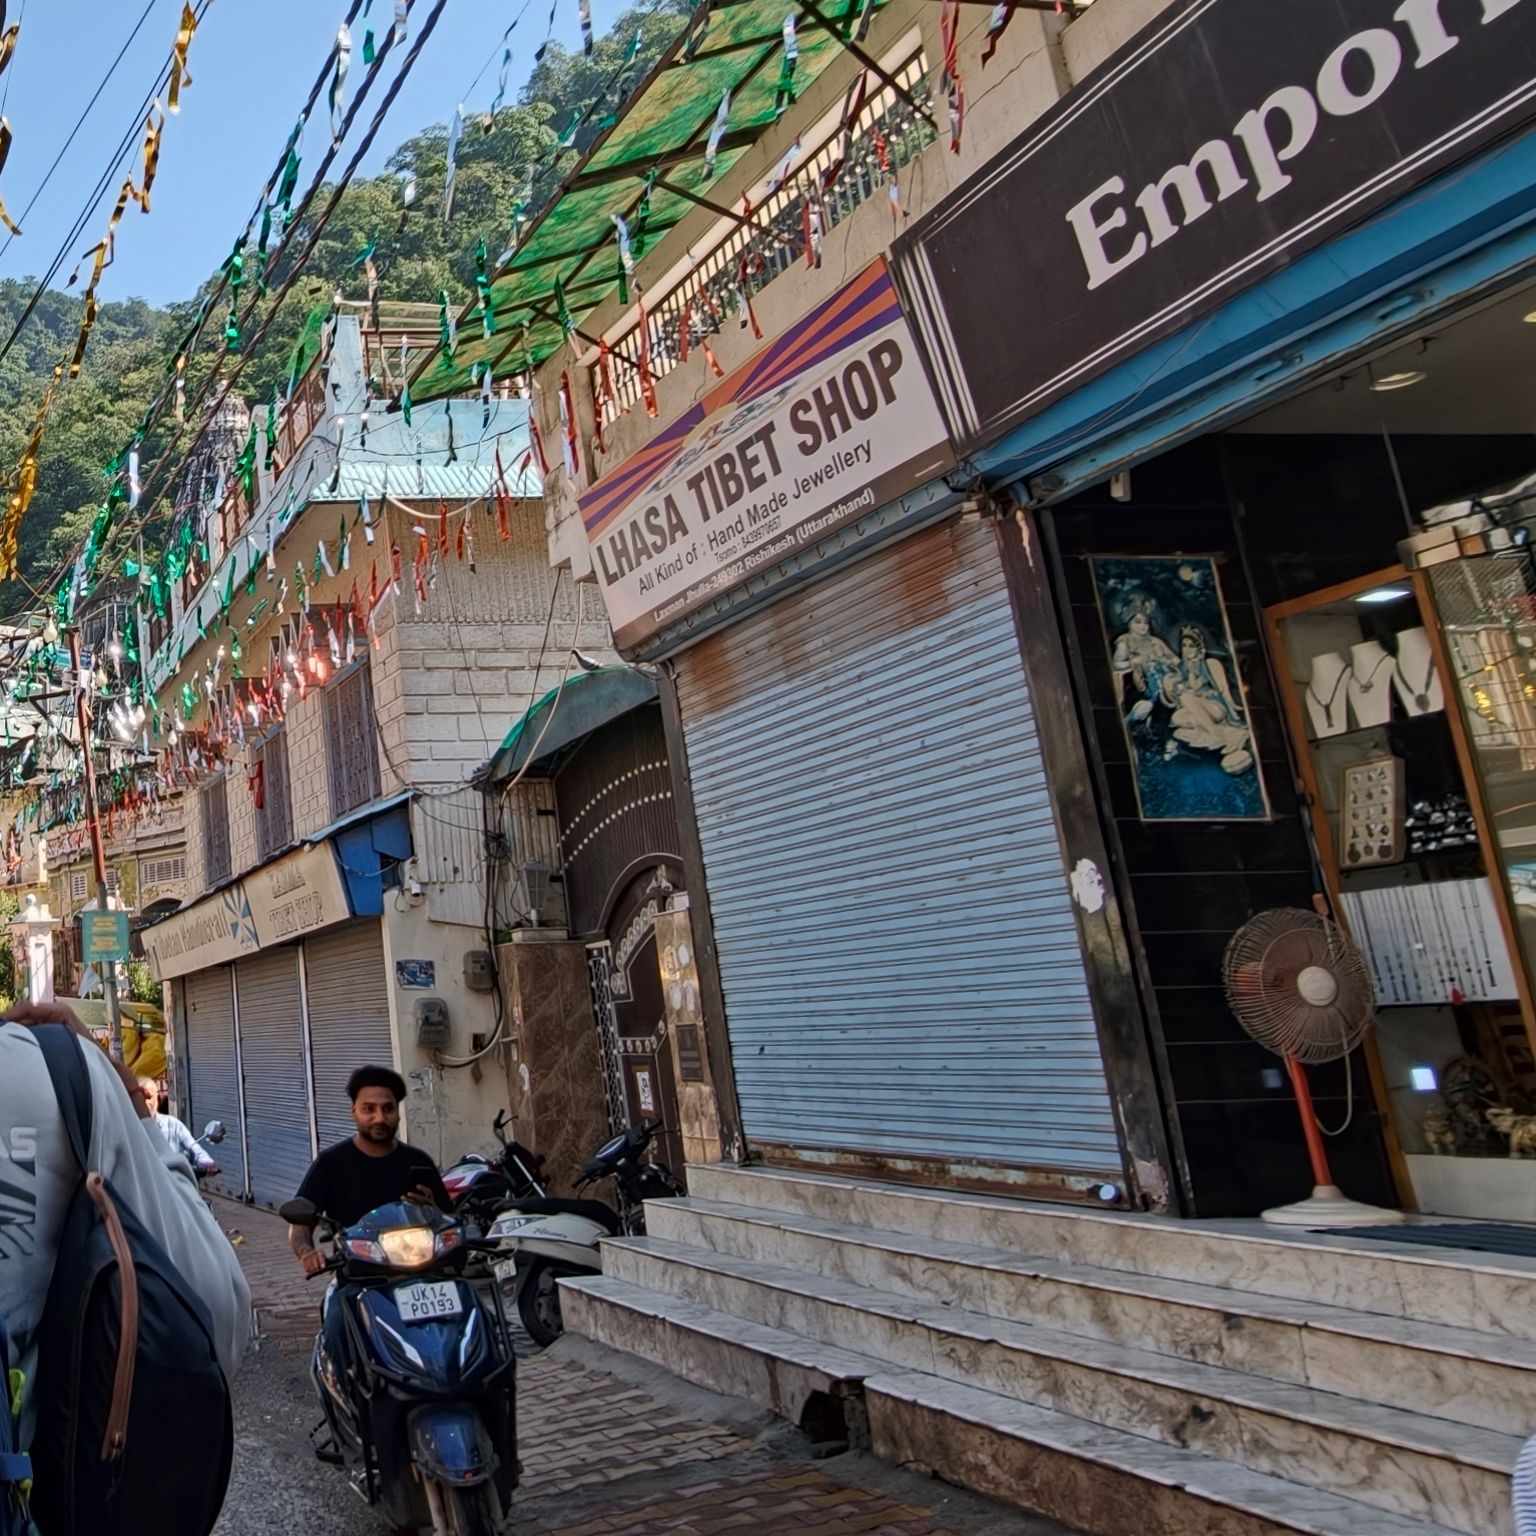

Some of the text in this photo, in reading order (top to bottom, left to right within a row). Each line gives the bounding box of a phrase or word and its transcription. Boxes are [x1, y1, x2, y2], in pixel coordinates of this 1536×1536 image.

[596, 338, 903, 587] LHASA TIBET SHOP
[639, 574, 655, 595] All
[654, 552, 684, 585] Kind
[685, 542, 699, 565] of
[706, 513, 745, 552] Hand
[746, 492, 789, 528] Made
[792, 439, 872, 500] Jewellery
[743, 533, 796, 572] Rishikesh
[795, 486, 875, 545] (Uttarakhand)
[411, 1285, 447, 1302] UK14
